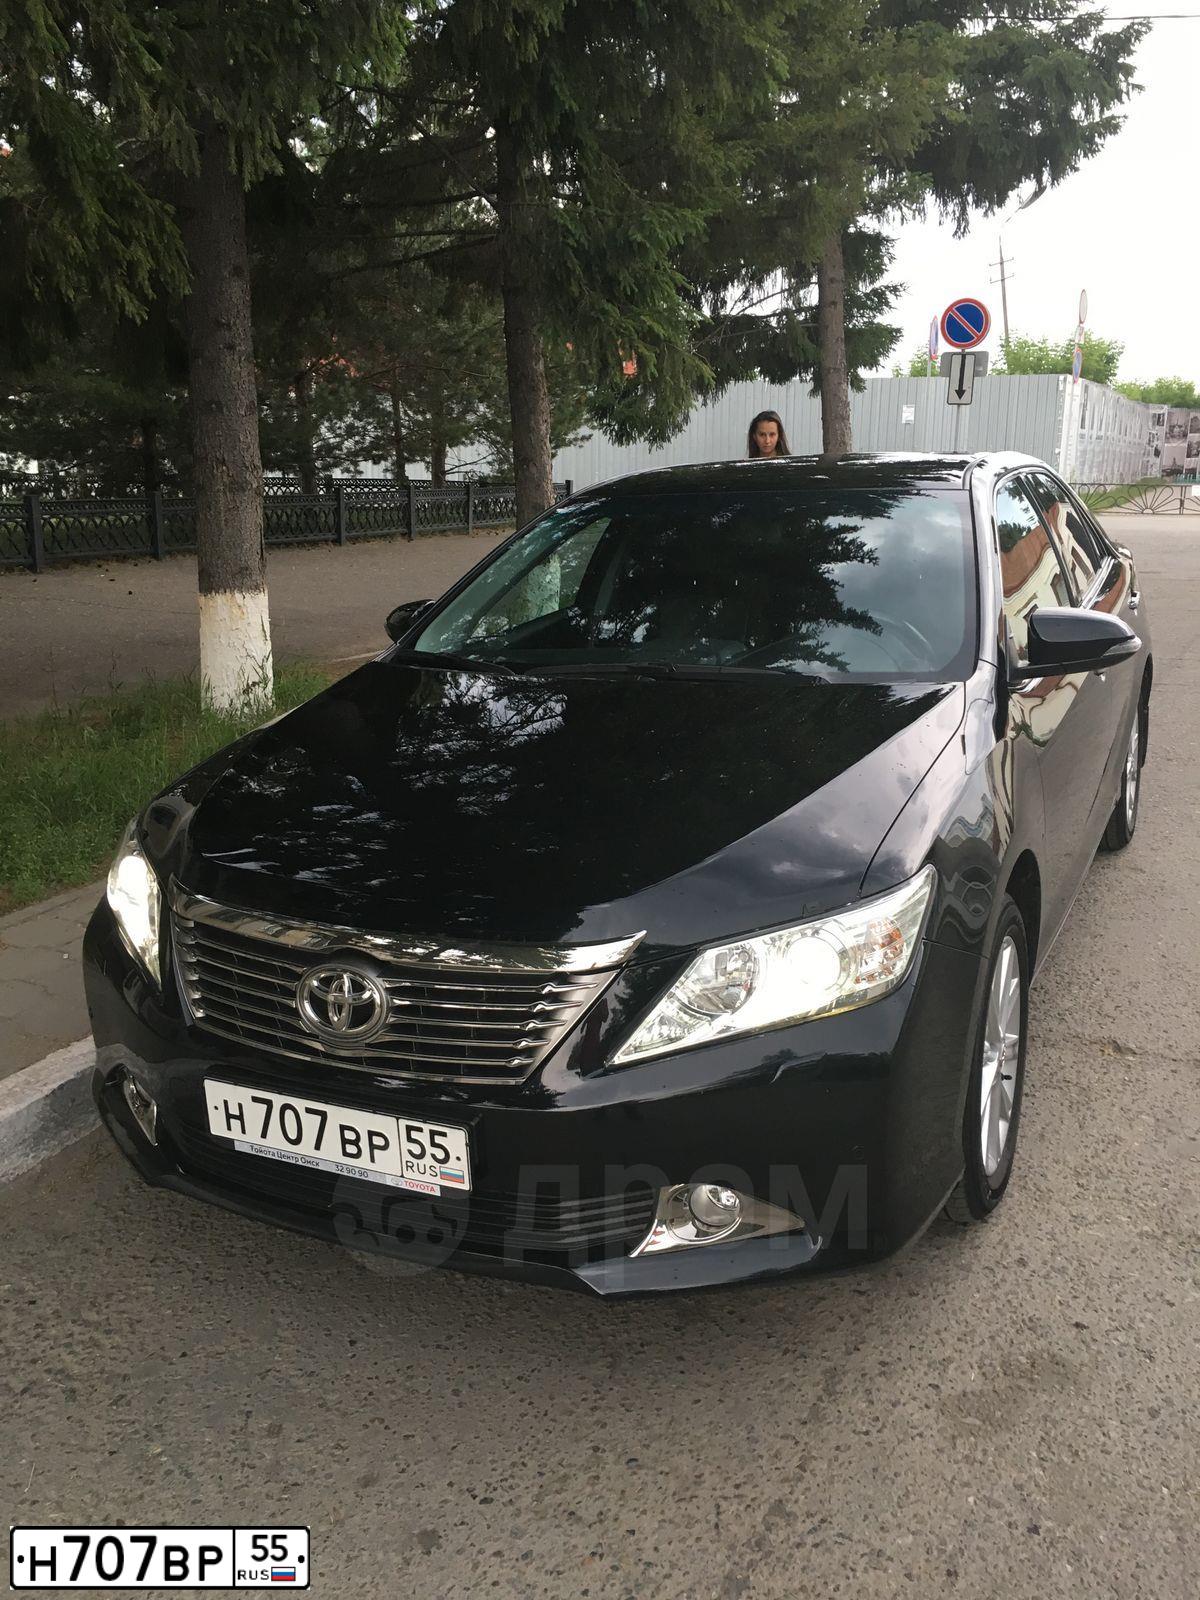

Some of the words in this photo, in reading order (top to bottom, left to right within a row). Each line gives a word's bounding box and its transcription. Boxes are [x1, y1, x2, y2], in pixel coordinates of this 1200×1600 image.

[223, 1095, 390, 1164] Н707ВР
[405, 1124, 450, 1165] 55
[250, 1145, 276, 1158] Тойота
[277, 1151, 299, 1163] Центр
[300, 1157, 320, 1167] Омск
[335, 1164, 344, 1173] 32
[405, 1160, 438, 1178] RUS
[404, 1180, 436, 1193] TOYOTA
